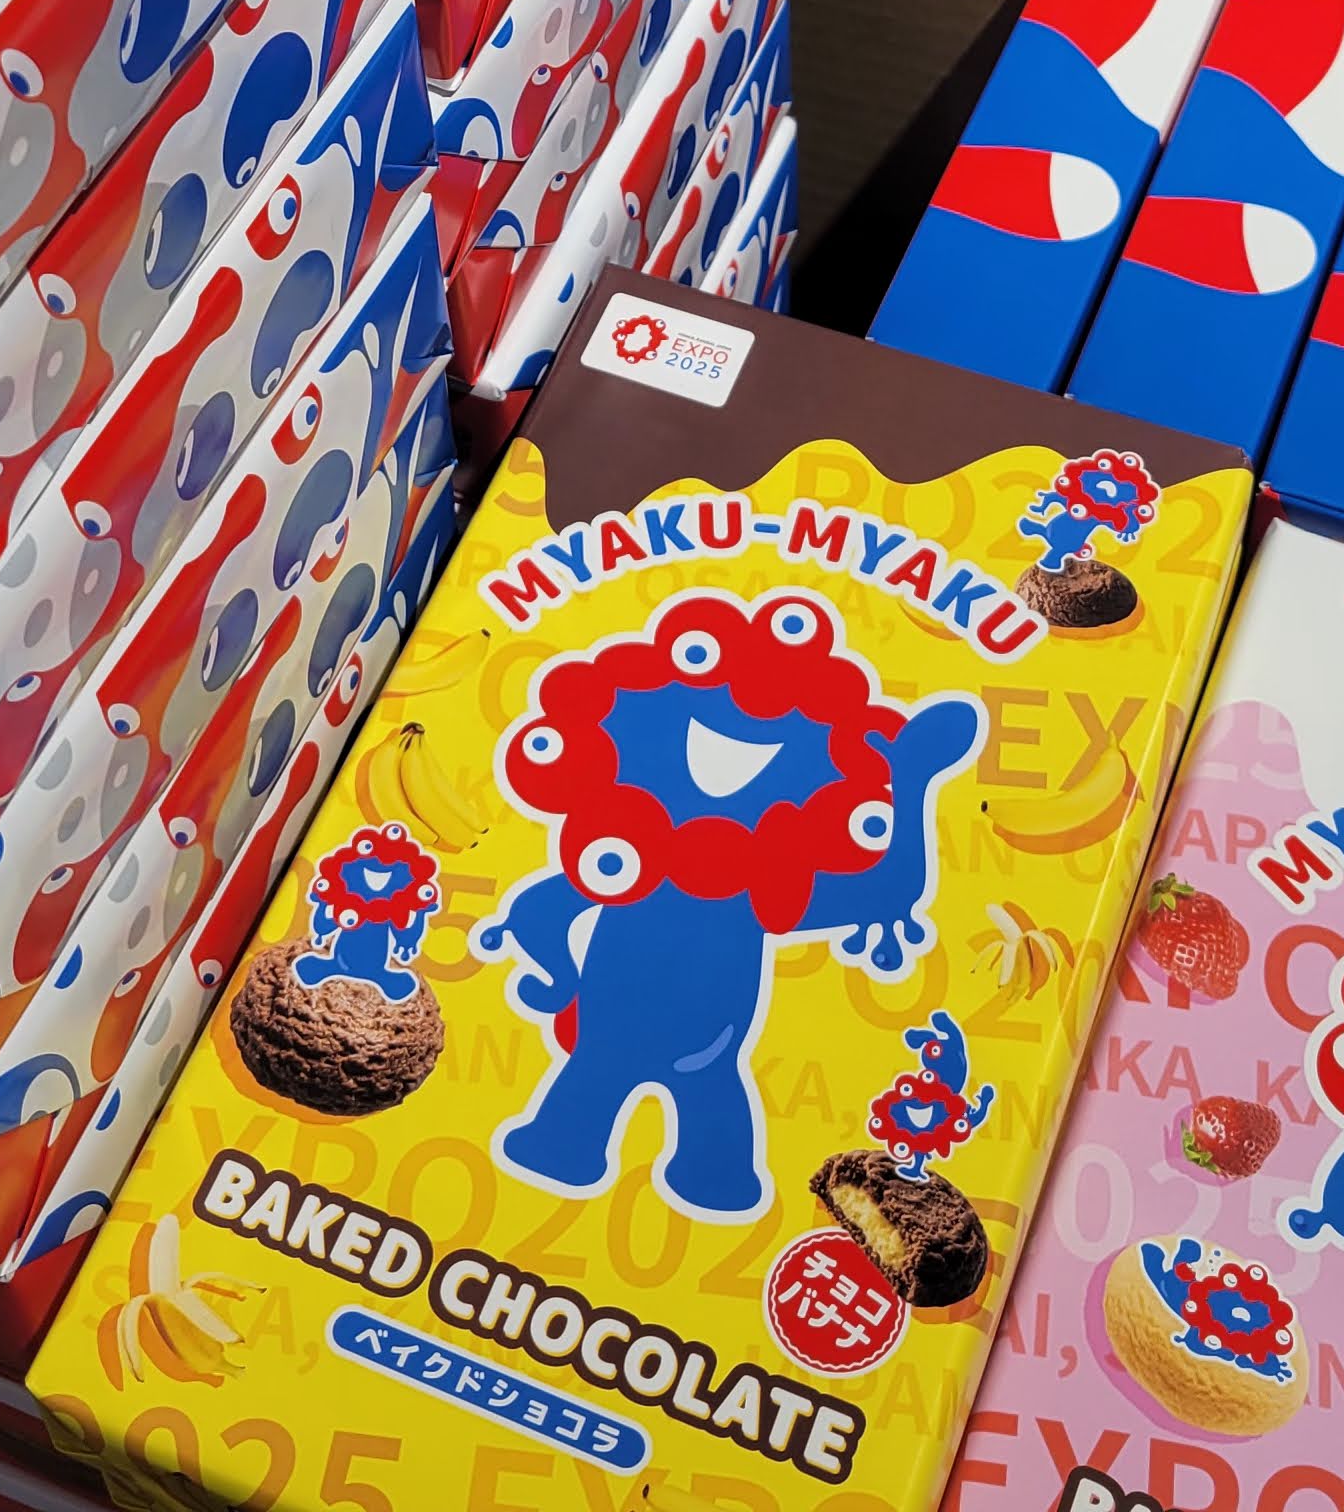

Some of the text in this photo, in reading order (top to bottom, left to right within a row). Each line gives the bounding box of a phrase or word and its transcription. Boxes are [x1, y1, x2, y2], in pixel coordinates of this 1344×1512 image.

[665, 352, 723, 379] 2025
[672, 337, 729, 365] EXPO
[486, 499, 1040, 653] MYAKU-MYAKU
[201, 1156, 425, 1292] BAKED
[775, 1280, 874, 1352] バナナ
[798, 1245, 895, 1323] チョコ
[352, 1323, 624, 1457] ベイクドショコラ
[435, 1258, 859, 1477] CHOCOLATE
